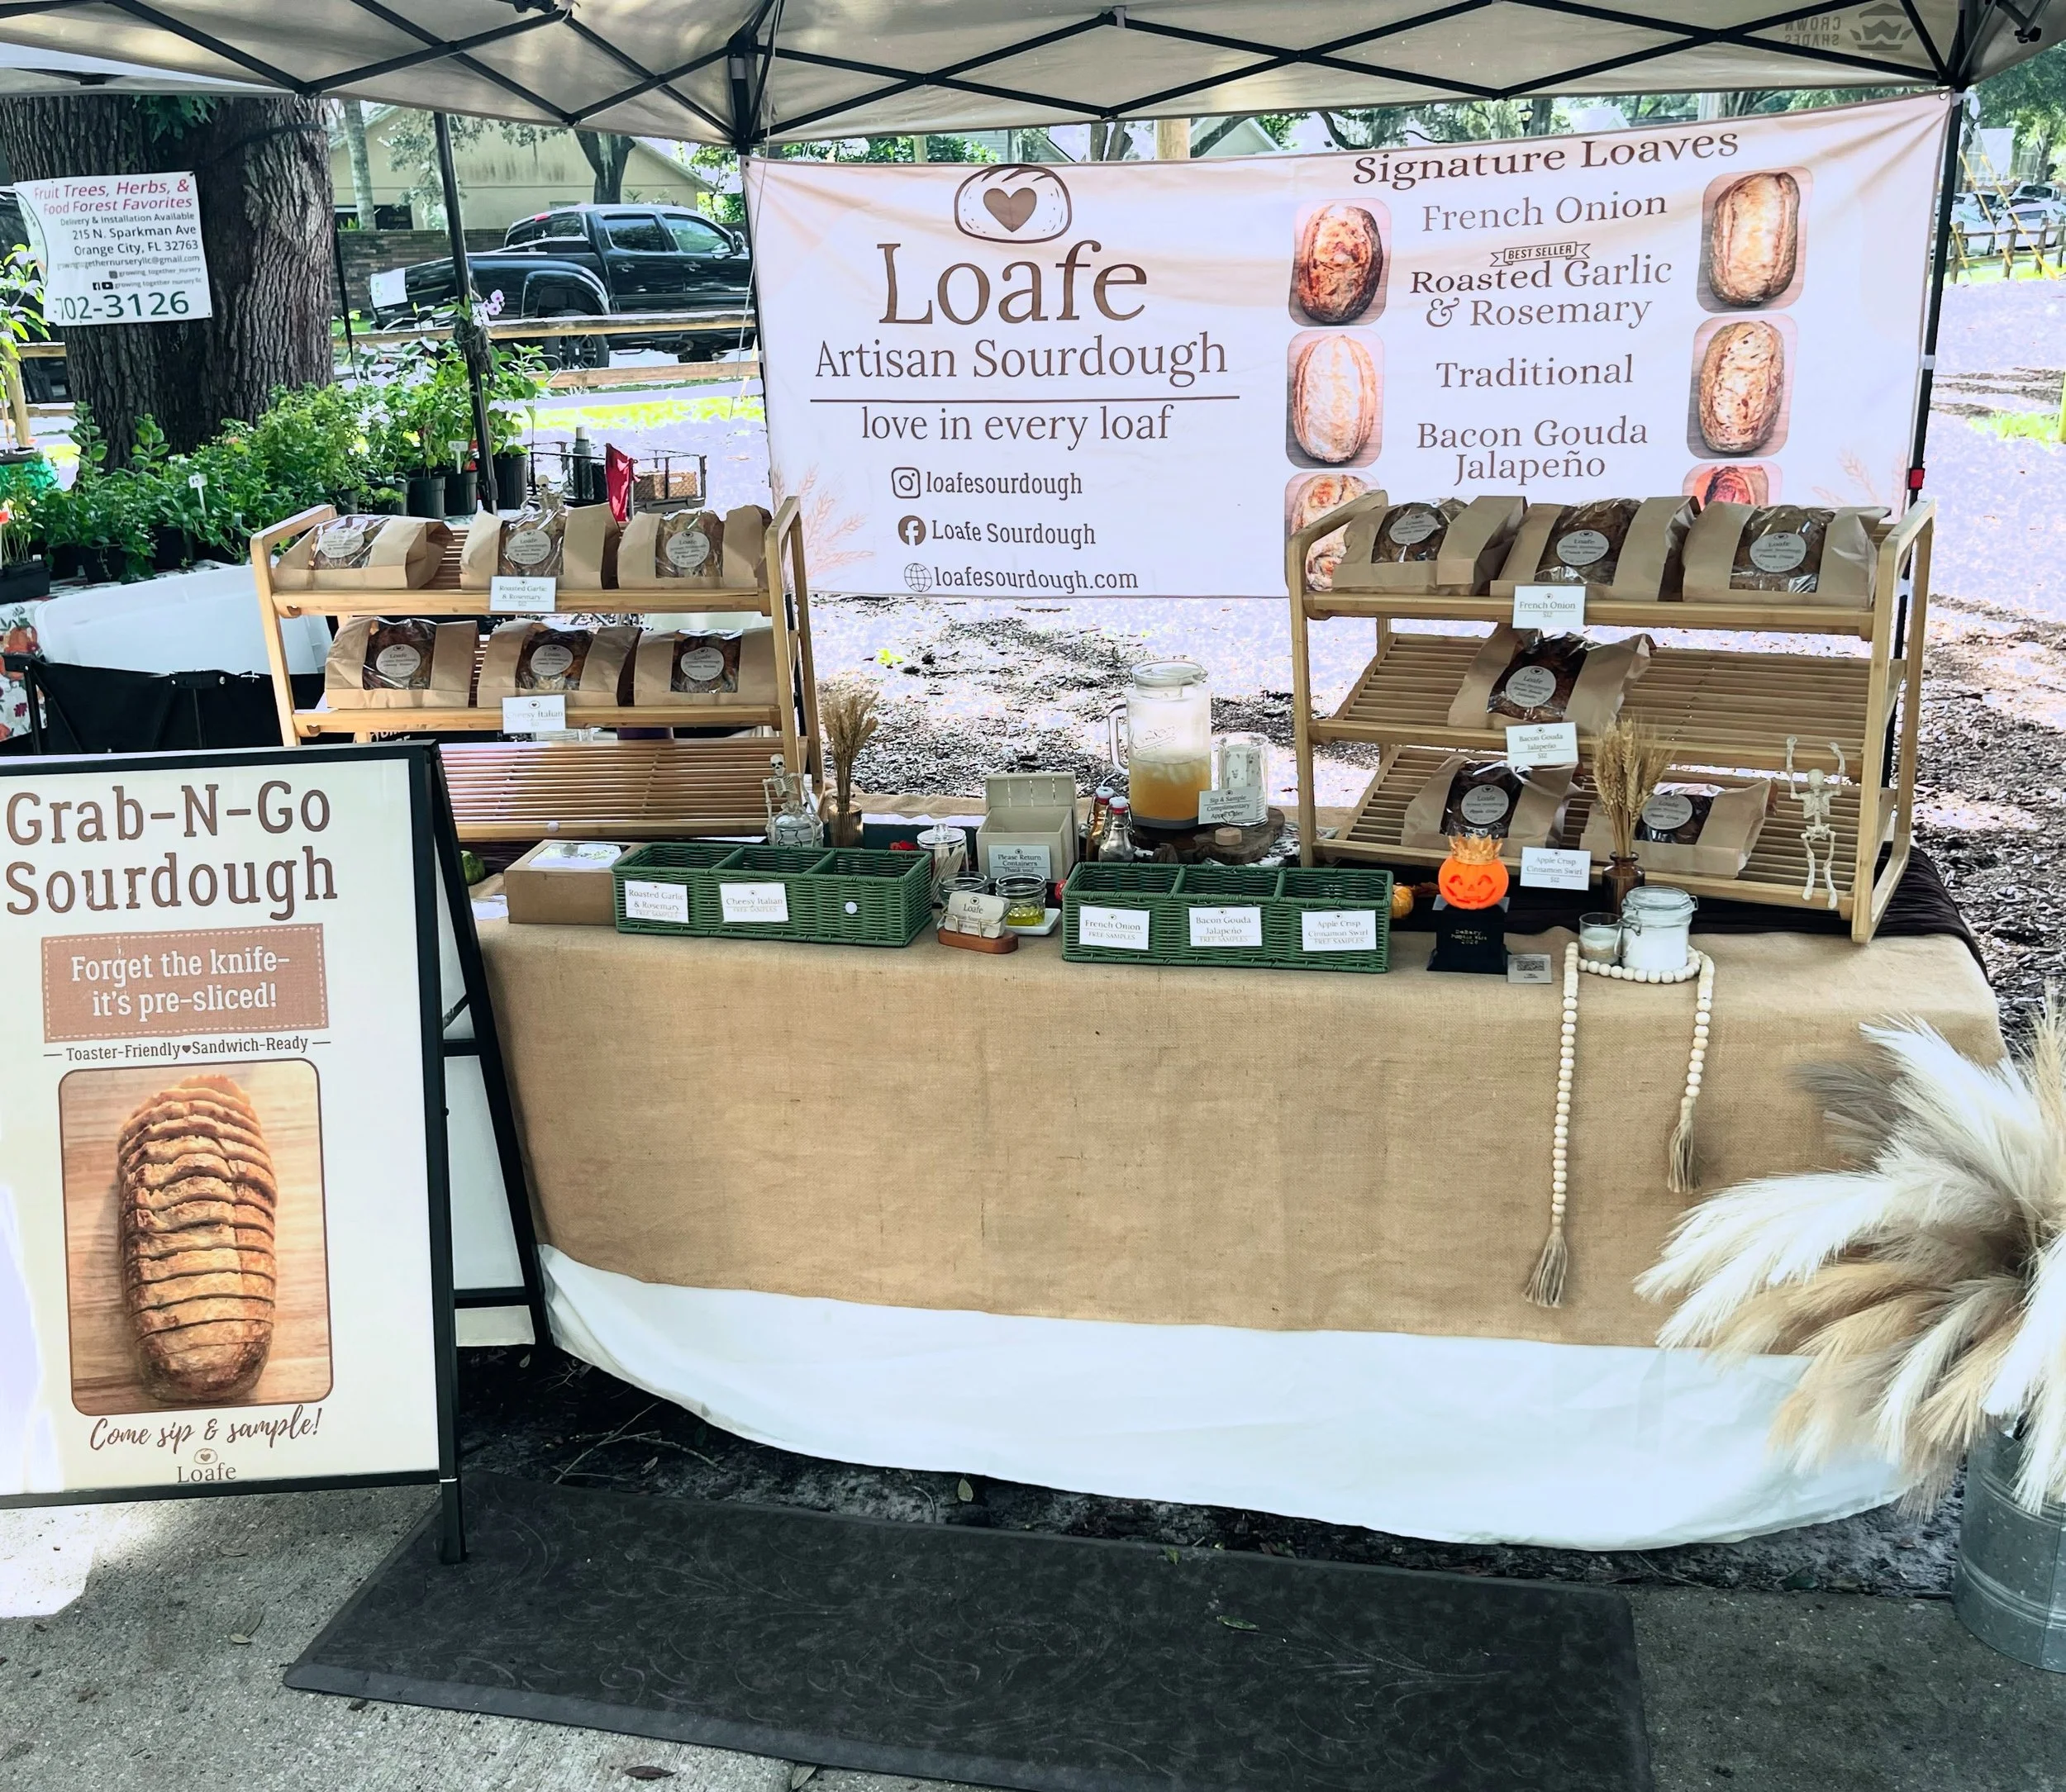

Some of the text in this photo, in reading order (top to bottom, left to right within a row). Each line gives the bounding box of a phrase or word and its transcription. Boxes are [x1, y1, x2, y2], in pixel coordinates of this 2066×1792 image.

[1353, 132, 1739, 191] Signature Loaves
[35, 178, 190, 201] Fruit Trees, Herbs, &
[44, 202, 69, 215] Food
[74, 201, 117, 212] Forest
[123, 197, 193, 211] Favorites
[60, 217, 90, 226] Delivery
[101, 214, 152, 224] Installation
[155, 212, 195, 221] Available
[1421, 191, 1668, 232] French Onion
[73, 225, 196, 240] 215 N. Sparkman Ave
[74, 240, 198, 258] Orange City, FL 32763
[1508, 244, 1573, 260] BEST SELLER
[877, 240, 1148, 325] Loafe
[1410, 254, 1673, 294] Roasted Garlic
[1426, 297, 1653, 329] & Rosemary
[816, 331, 1228, 387] Artisan Sourdough
[1435, 354, 1634, 387] Traditional
[862, 404, 1175, 451] love in every loaf
[1417, 416, 1648, 449] Bacon Gouda
[1454, 449, 1606, 487] Jalapeño
[926, 471, 1083, 501] loafesourdough
[932, 520, 1097, 550] Loafe Sourdough
[934, 566, 1139, 594] loafesourdough.com
[1519, 601, 1576, 610] French Onion
[1540, 733, 1564, 741] Gouda
[7, 779, 331, 847] Grab-N-Go
[1207, 803, 1250, 813] Complimentary
[1225, 795, 1247, 803] Sample
[5, 845, 339, 921] Sourdough
[629, 889, 659, 899] Roasted
[726, 897, 783, 908] Cheesy Italian
[963, 903, 983, 915] Loafe
[1085, 920, 1140, 930] French Onion
[71, 953, 152, 987] Forget
[160, 948, 202, 977] the
[139, 982, 278, 1023] pre-sliced!
[89, 1405, 322, 1455] Come sip & sample!
[177, 1462, 237, 1483] Loafe
